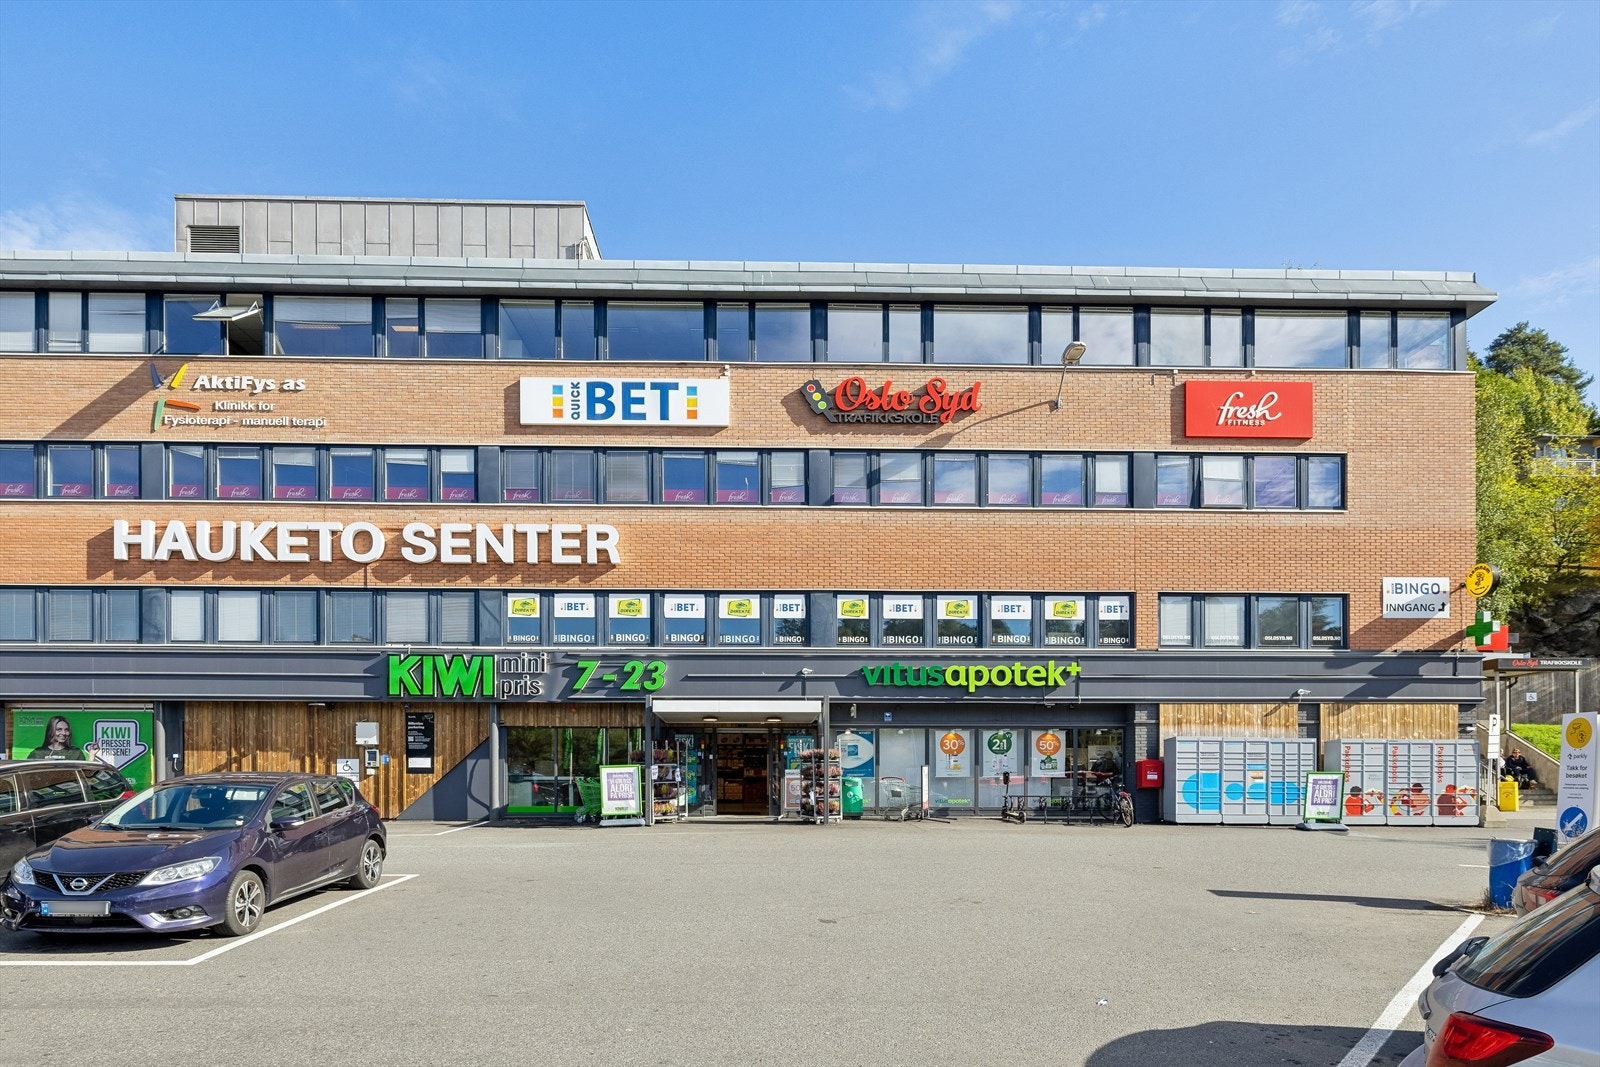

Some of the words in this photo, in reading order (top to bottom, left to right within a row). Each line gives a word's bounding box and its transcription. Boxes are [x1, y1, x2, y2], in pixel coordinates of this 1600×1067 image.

[193, 375, 276, 393] AktiFys
[281, 379, 306, 391] as
[571, 381, 580, 421] QUICK
[586, 381, 679, 421] BET
[835, 376, 915, 411] Oslo
[919, 377, 982, 423] Syd
[215, 401, 255, 411] Klinikk
[258, 401, 275, 411] for
[1218, 391, 1282, 425] fresh
[164, 414, 230, 427] Fysioterapi
[242, 416, 288, 426] manuell
[292, 416, 326, 428] terapi
[837, 412, 939, 424] TRAFIKKSKOLE
[178, 486, 198, 496] fresh
[231, 487, 250, 497] fresh
[287, 487, 306, 497] fresh
[343, 488, 362, 498] fresh
[398, 489, 417, 499] fresh
[449, 489, 468, 499] fresh
[675, 491, 694, 501] fresh
[728, 491, 747, 501] fresh
[113, 519, 386, 564] HAUKETO
[401, 521, 621, 566] SENTER
[1395, 583, 1440, 595] BINGO
[567, 602, 585, 611] BET
[677, 603, 695, 611] BET
[782, 603, 800, 612] BET
[895, 604, 913, 612] BET
[1004, 604, 1022, 613] BET
[1106, 605, 1124, 613] BET
[1386, 603, 1435, 612] INNGANG
[513, 634, 536, 642] BINGO
[560, 634, 591, 643] BINGO
[615, 634, 645, 642] BINGO
[670, 634, 700, 642] BINGO
[725, 635, 755, 643] BINGO
[889, 635, 919, 644] BINGO
[943, 635, 973, 644] BINGO
[997, 635, 1026, 643] BINGO
[1051, 636, 1081, 645] BINGO
[500, 652, 547, 674] mini
[388, 654, 495, 697] KIWI
[572, 660, 600, 691] 7
[620, 660, 667, 692] 23
[500, 675, 542, 699] pris
[101, 727, 131, 739] KIWI
[101, 740, 131, 748] PRESSER
[943, 739, 965, 750] 30%
[1039, 740, 1060, 750] 50%
[101, 748, 131, 756] PRISENE!
